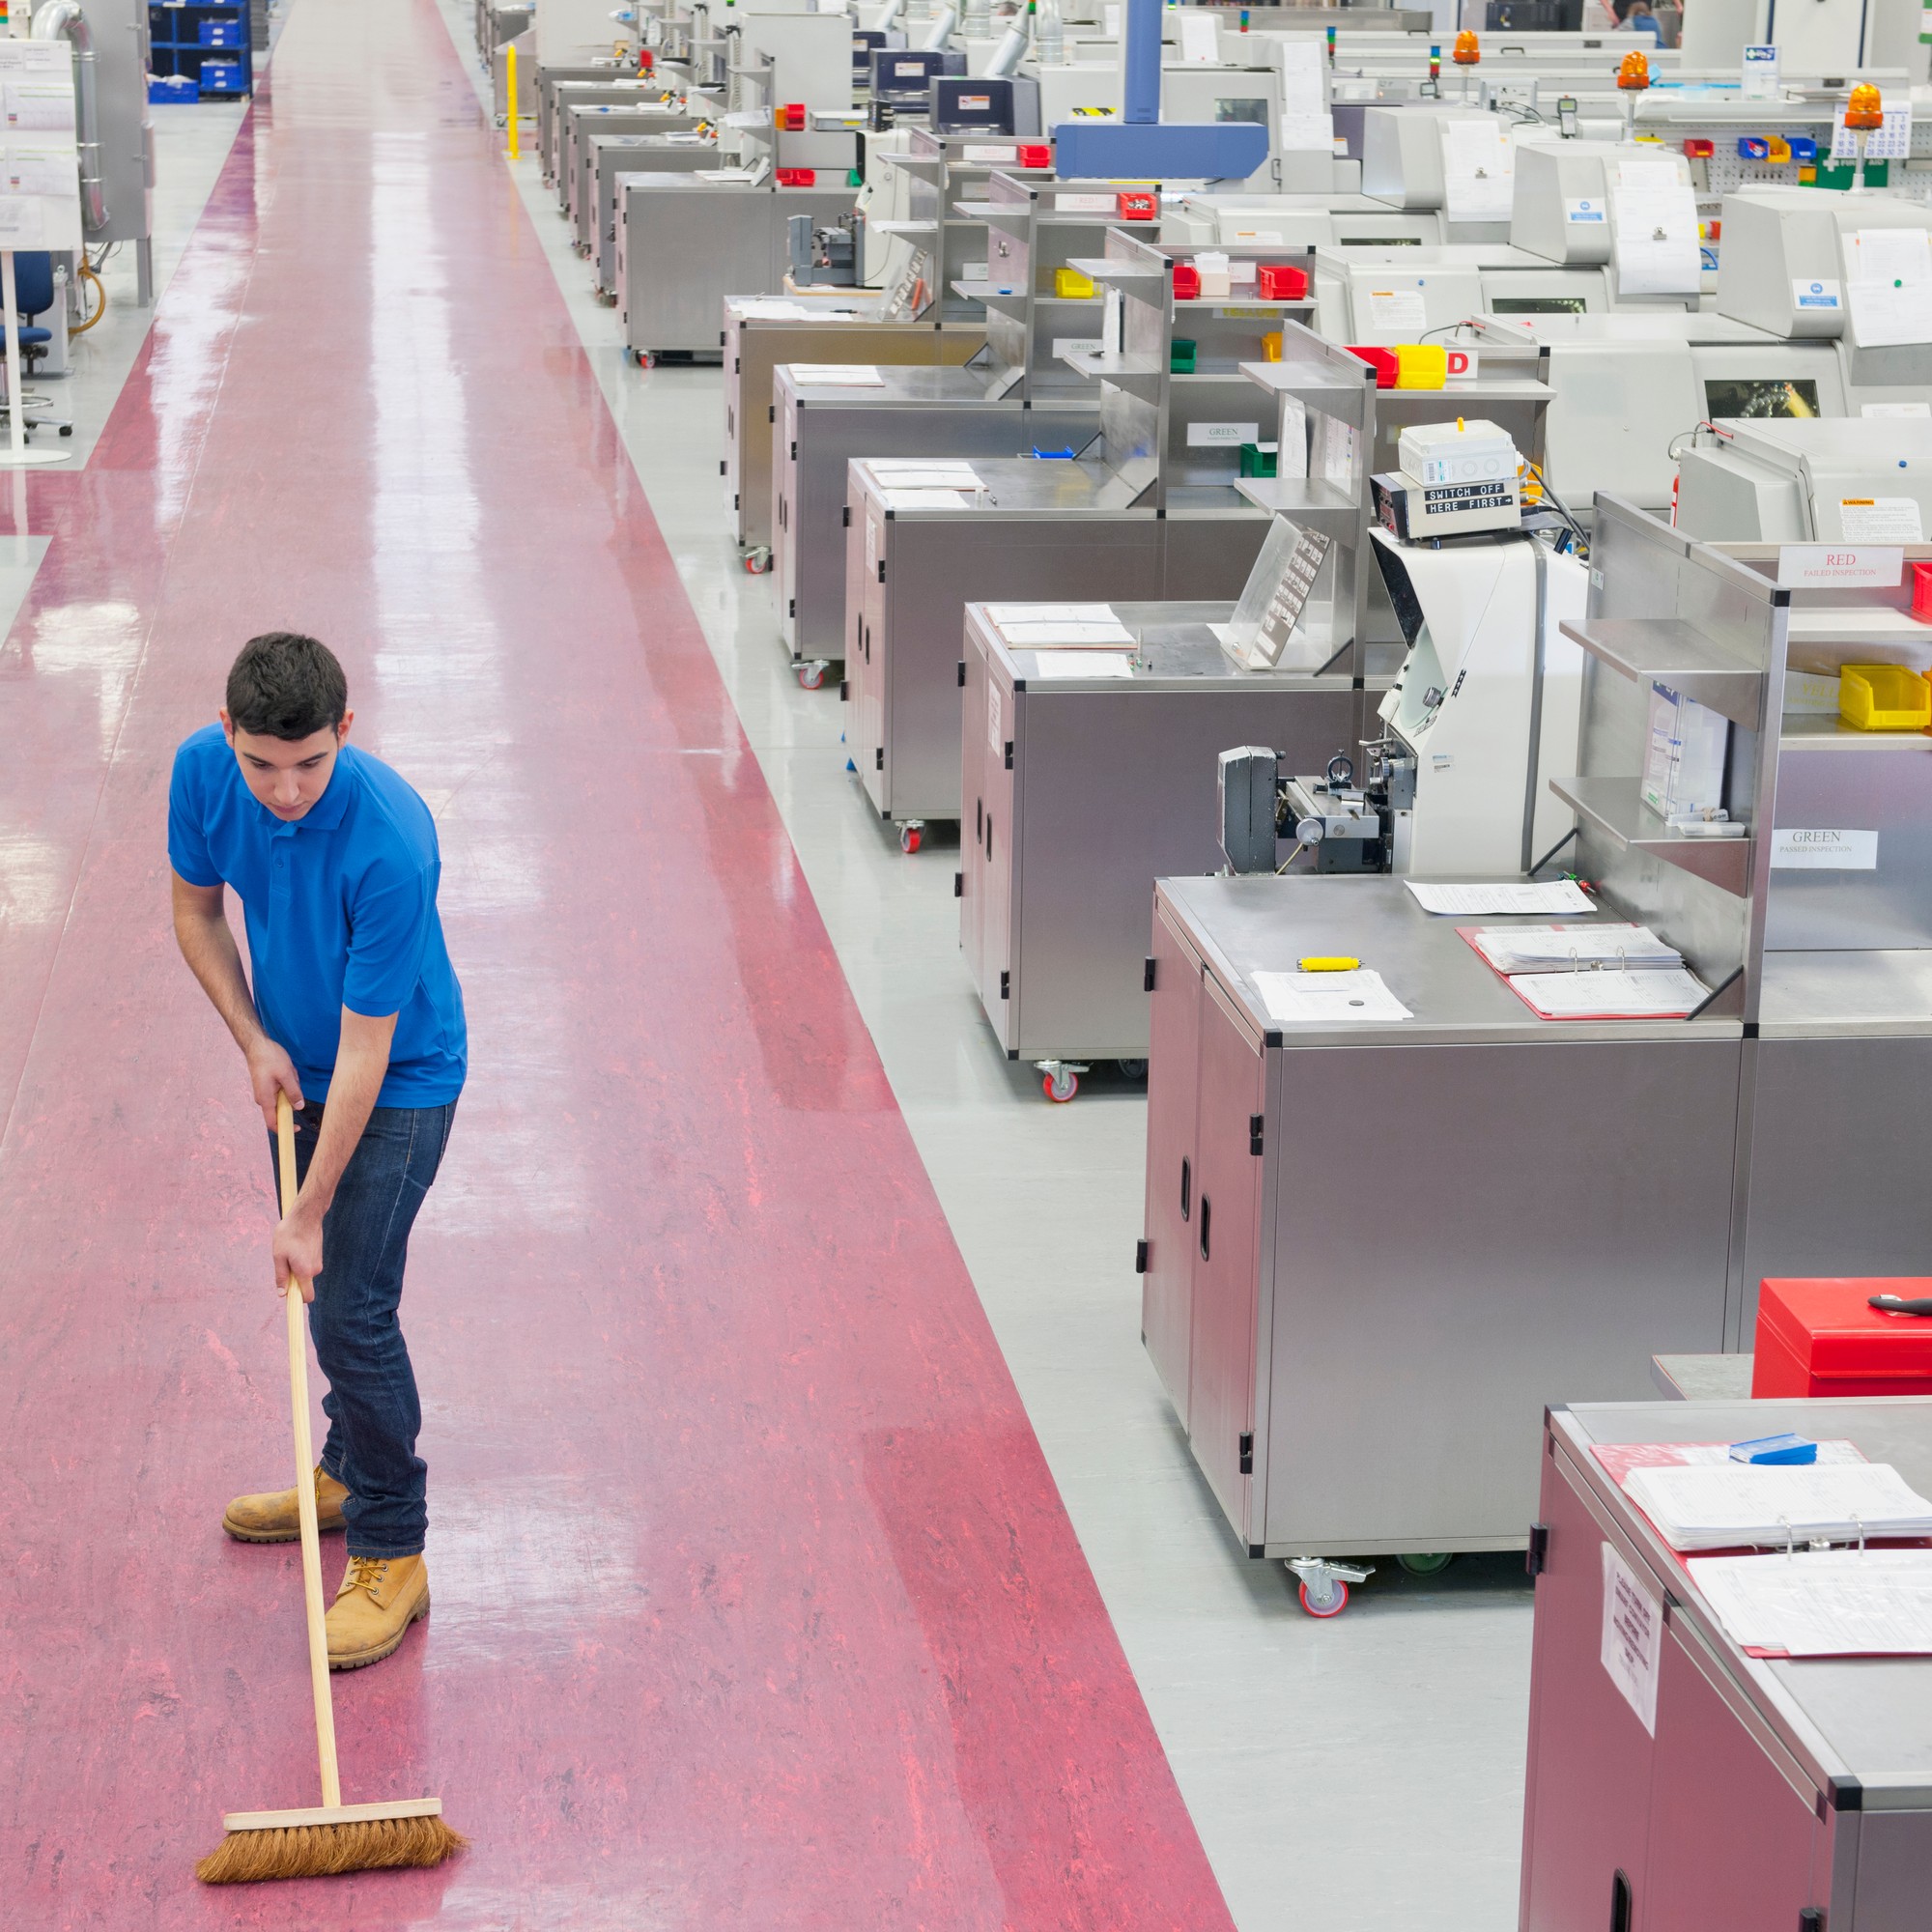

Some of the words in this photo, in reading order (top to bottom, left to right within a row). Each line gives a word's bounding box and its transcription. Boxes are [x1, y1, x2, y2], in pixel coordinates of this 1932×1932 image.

[1430, 488, 1471, 500] SWITCH
[1480, 484, 1501, 495] OFF
[1430, 502, 1458, 513] HERE
[1469, 497, 1502, 509] FIRST
[1826, 554, 1856, 566] RED
[1803, 681, 1839, 697] YELL
[1792, 831, 1841, 843] GREEN
